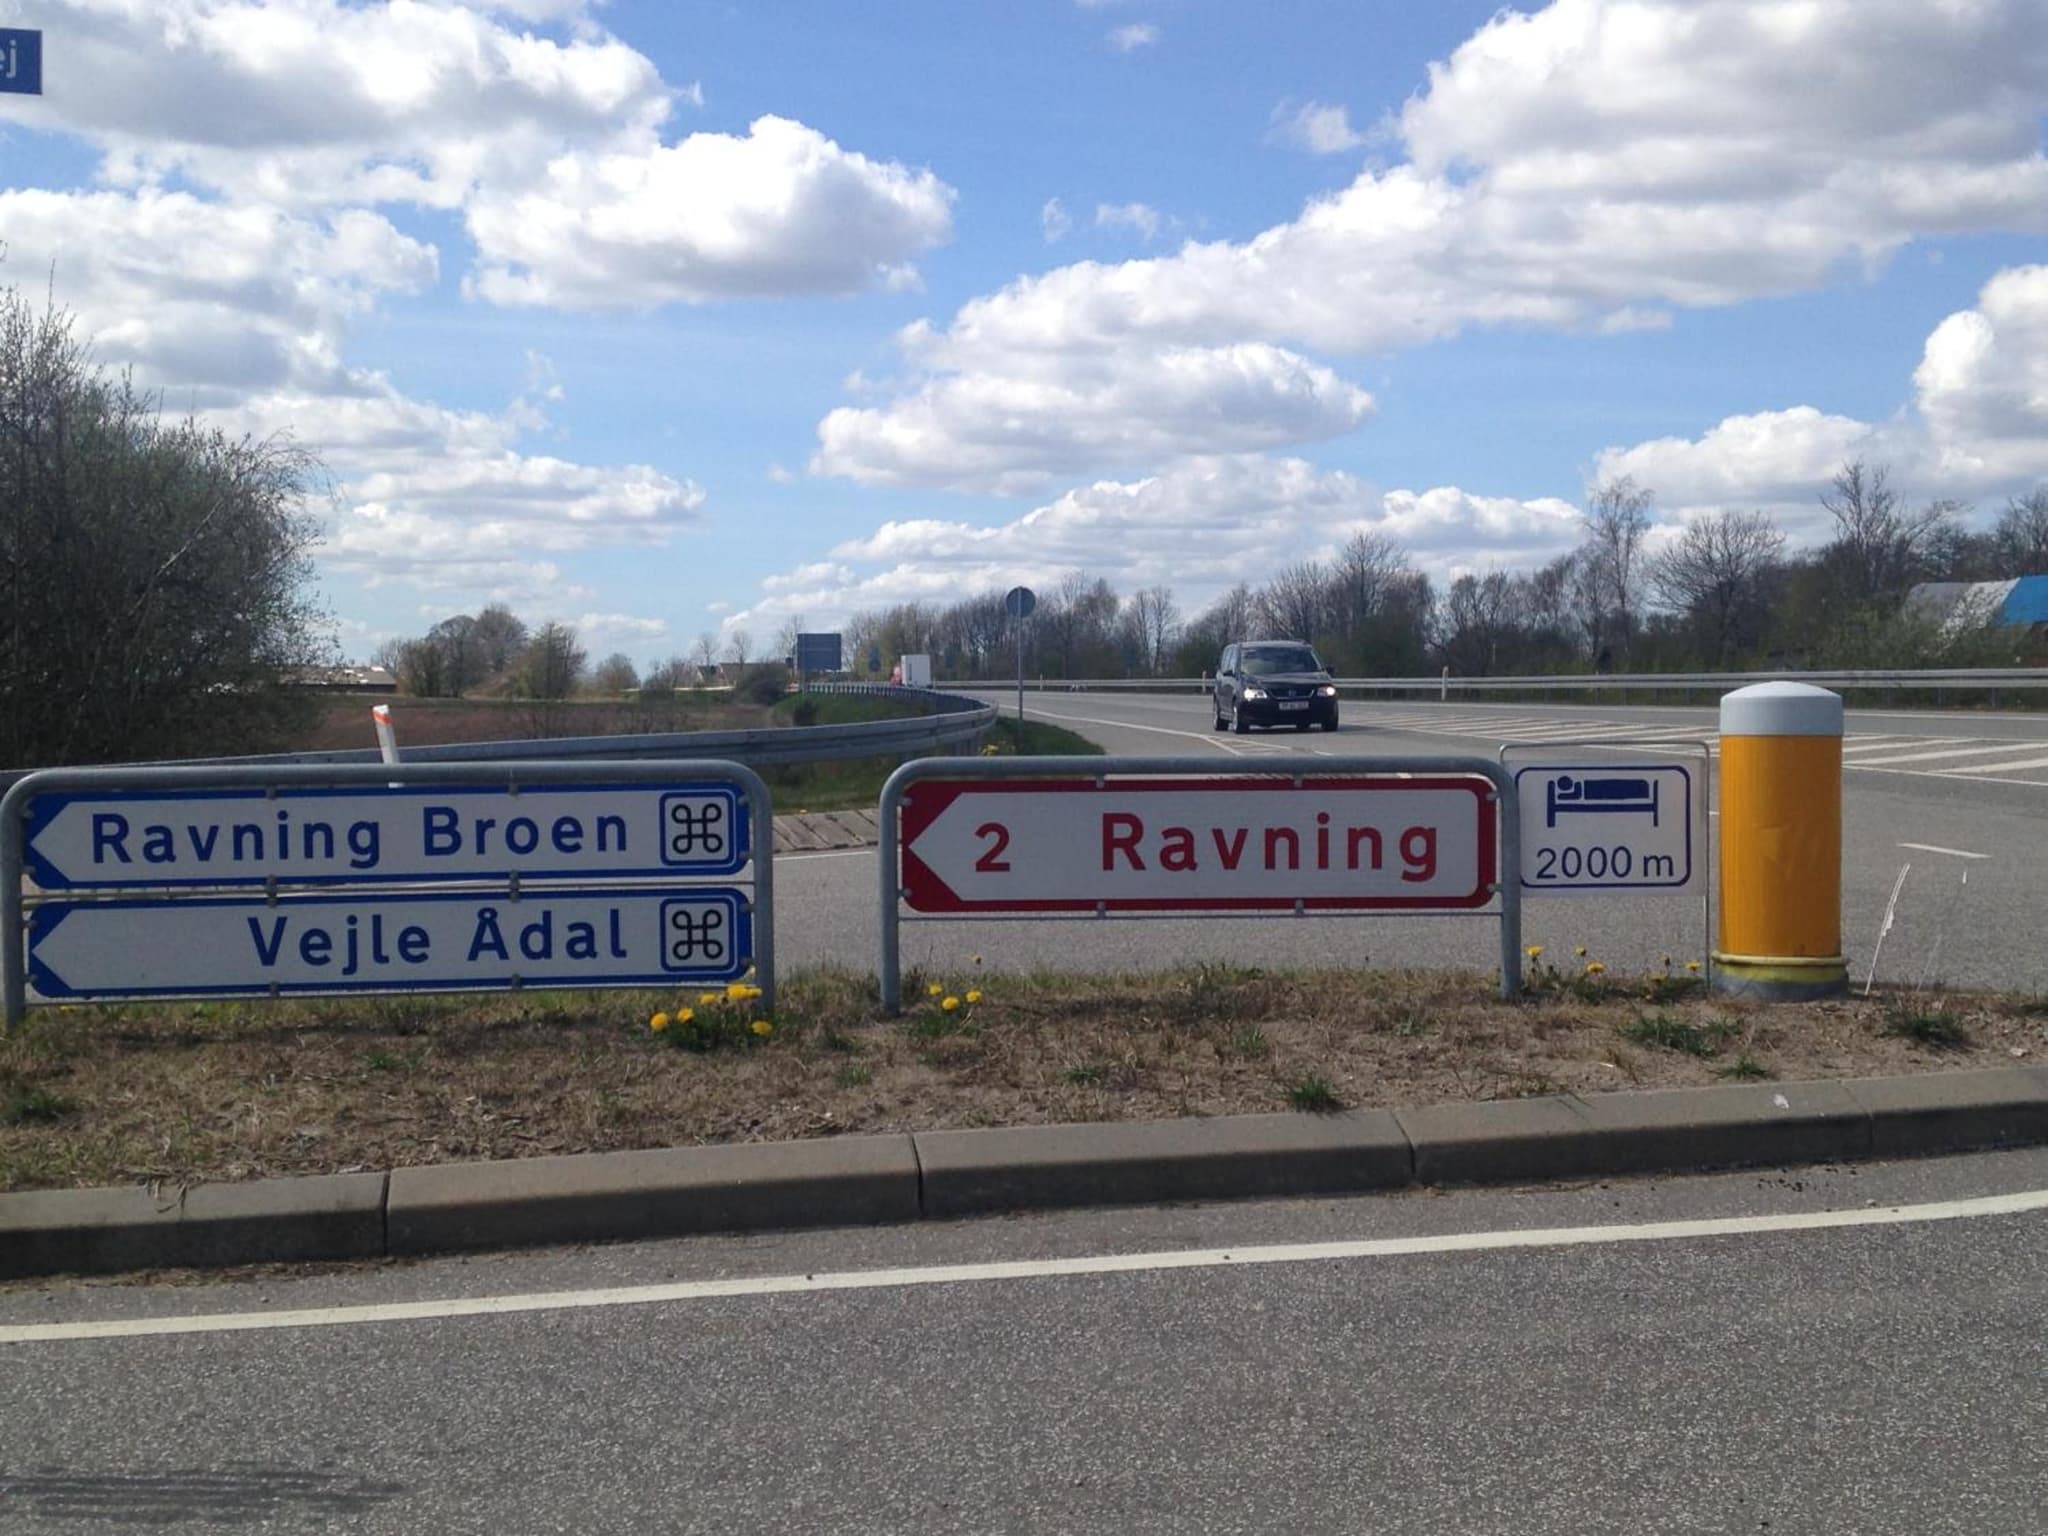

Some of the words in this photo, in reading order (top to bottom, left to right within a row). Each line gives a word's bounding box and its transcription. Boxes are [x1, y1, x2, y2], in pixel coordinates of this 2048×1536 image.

[90, 809, 381, 869] Ravning
[422, 804, 628, 858] Broen
[974, 821, 1011, 873] 2
[1101, 811, 1438, 882] Ravning
[1536, 846, 1632, 879] 2000
[1642, 854, 1674, 877] m
[246, 913, 432, 975] Vejle
[466, 907, 628, 964] Ådal
